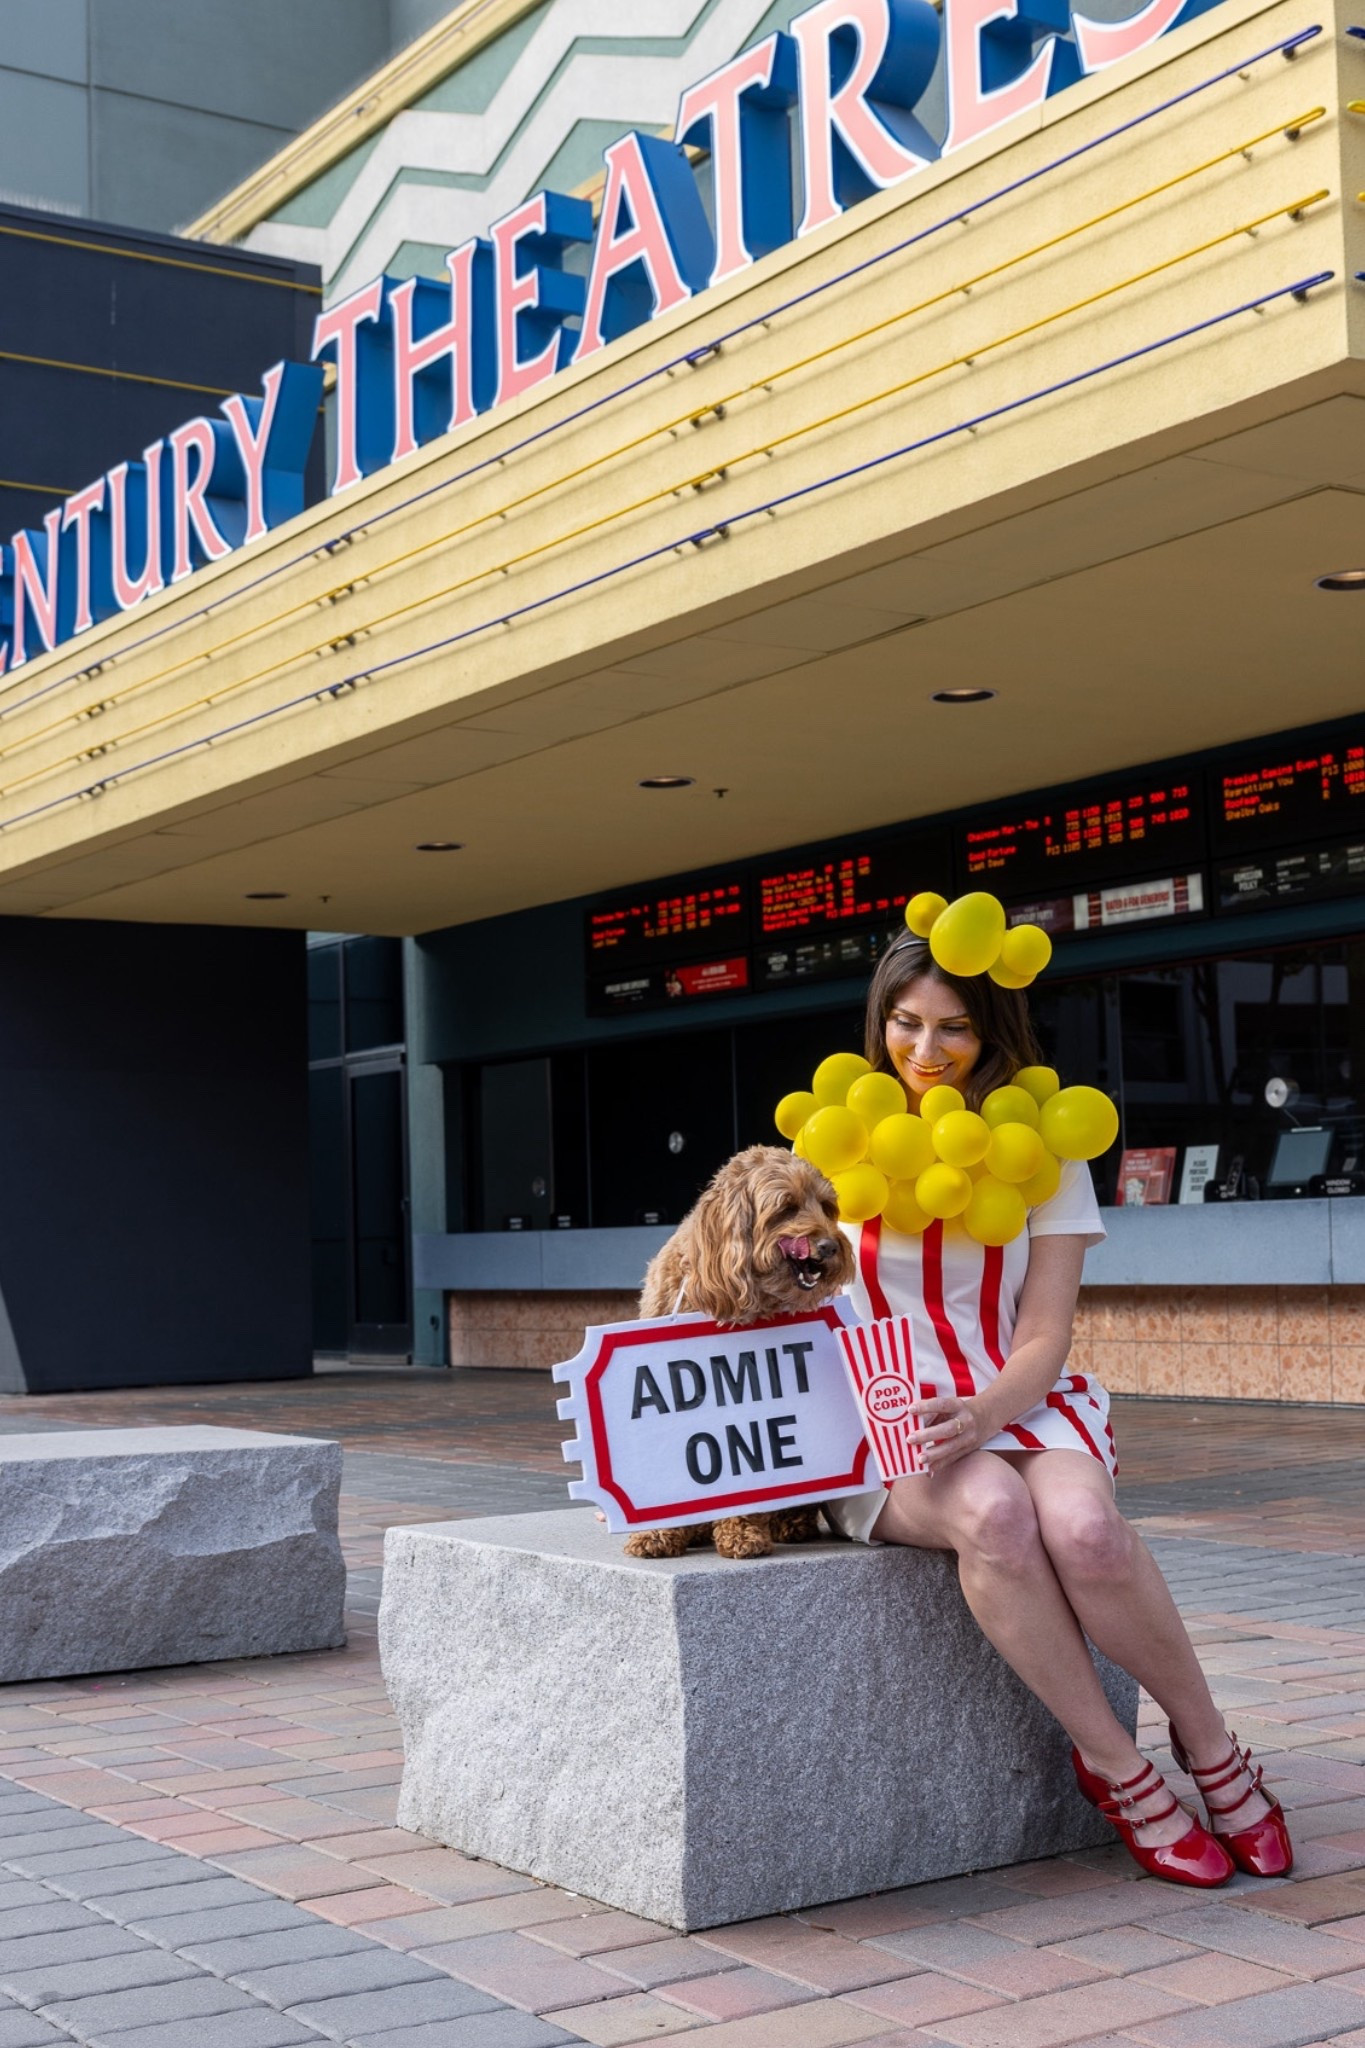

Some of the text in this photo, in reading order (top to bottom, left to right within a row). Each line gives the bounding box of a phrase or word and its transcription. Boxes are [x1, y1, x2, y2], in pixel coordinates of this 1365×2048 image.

[0, 359, 286, 675] NTURY
[631, 1342, 813, 1419] ADMIT
[873, 1396, 908, 1412] CORN
[874, 1384, 900, 1400] POP
[685, 1414, 804, 1484] ONE
